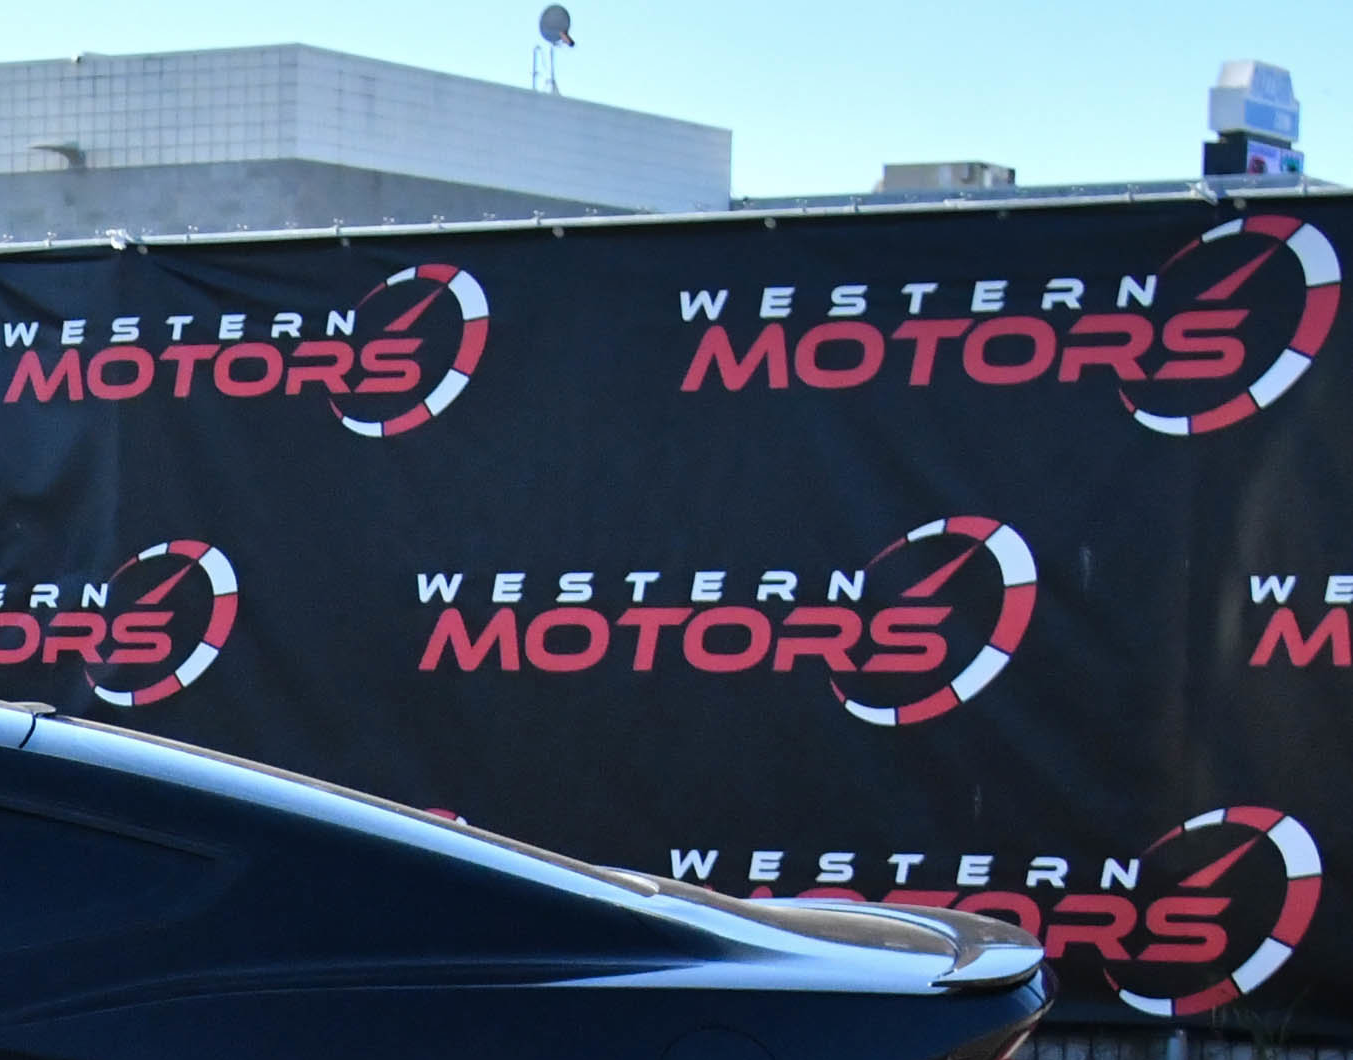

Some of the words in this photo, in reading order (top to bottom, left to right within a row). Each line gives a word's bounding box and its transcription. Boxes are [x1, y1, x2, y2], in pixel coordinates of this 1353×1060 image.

[679, 274, 1157, 321] WESTERN
[4, 309, 355, 348] WESTERN
[681, 310, 1249, 392] MOTORS
[4, 337, 423, 403] MOTORS
[416, 569, 865, 603] WESTERN
[418, 605, 953, 673] MOTORS
[670, 848, 1141, 889] WESTERN
